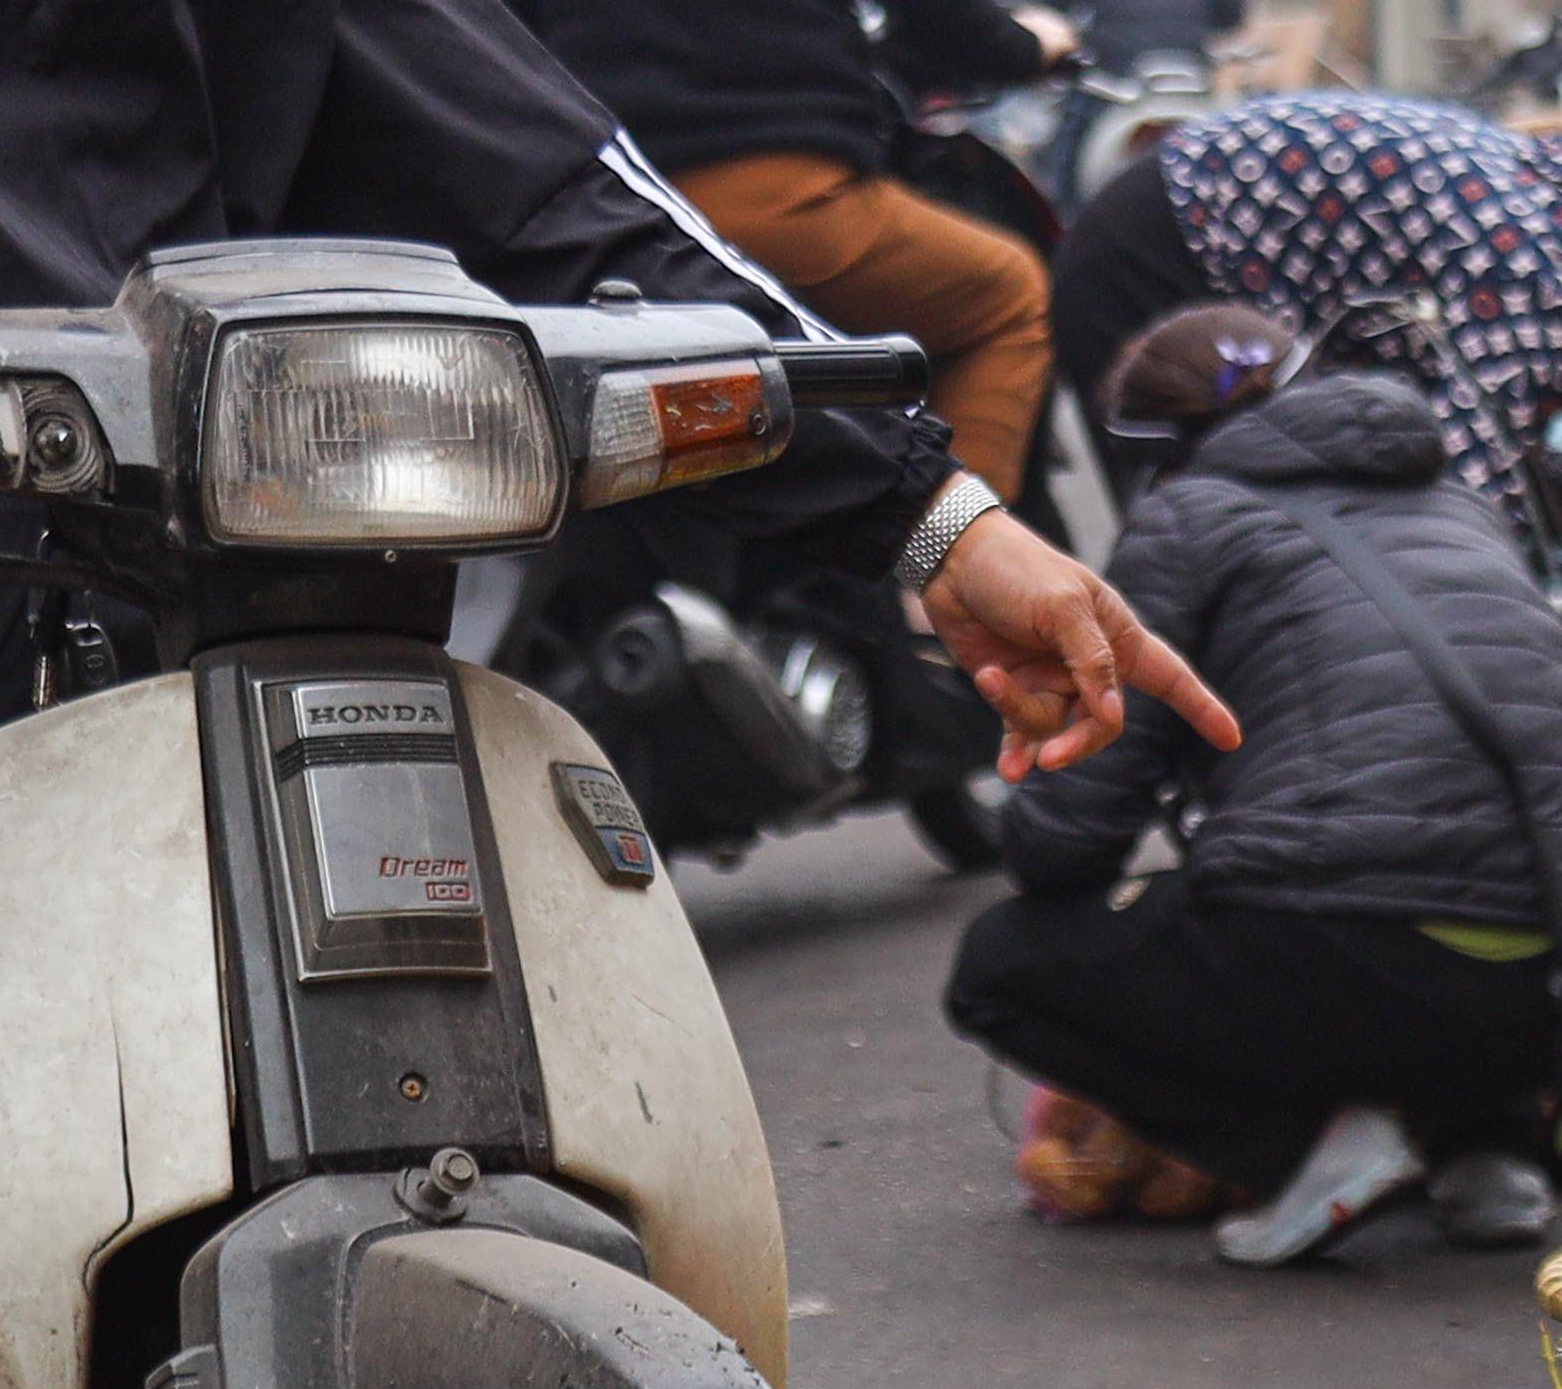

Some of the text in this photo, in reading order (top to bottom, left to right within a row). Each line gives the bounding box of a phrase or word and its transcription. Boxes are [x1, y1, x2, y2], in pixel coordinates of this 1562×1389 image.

[307, 705, 445, 724] HONDA
[378, 856, 467, 877] Dream
[427, 882, 470, 900] 100
